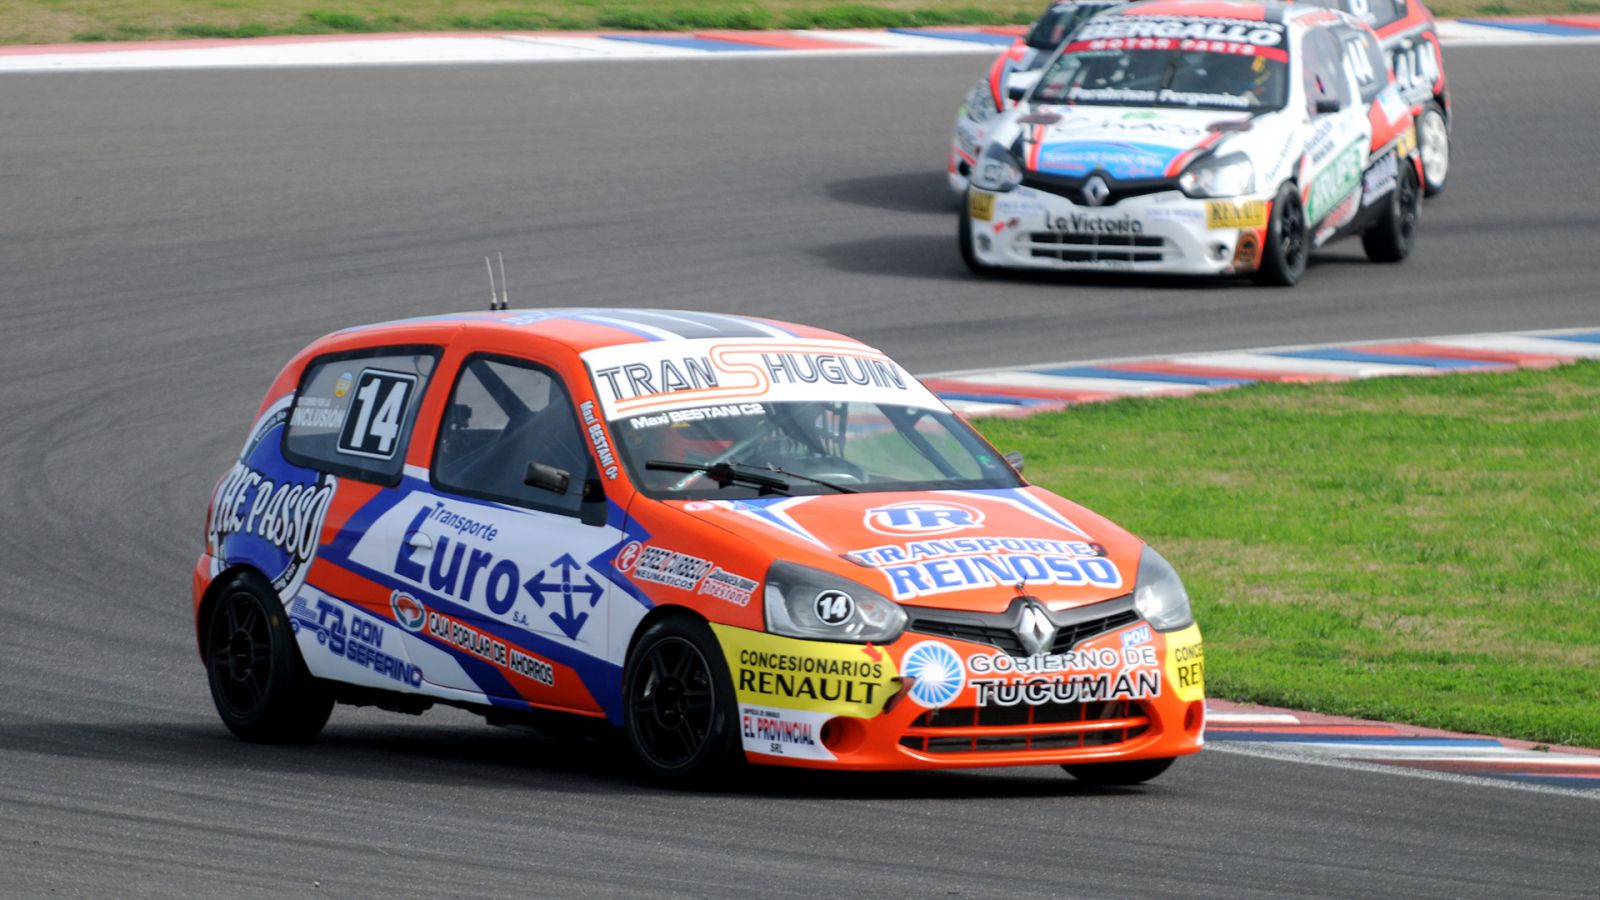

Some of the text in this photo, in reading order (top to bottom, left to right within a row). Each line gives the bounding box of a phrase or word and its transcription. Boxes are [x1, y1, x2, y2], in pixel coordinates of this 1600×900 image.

[1077, 20, 1282, 46] BERGALLO
[1089, 37, 1256, 55] MOTOR PARTS
[350, 378, 408, 452] 14
[630, 412, 670, 430] Maxi
[671, 405, 742, 424] BESTANI
[579, 400, 597, 427] Maxi
[588, 422, 616, 468] BESTANI
[429, 501, 499, 541] Transporte
[869, 506, 978, 528] TR
[394, 505, 520, 615] Euro
[855, 538, 1097, 565] TRANSPORTE
[635, 568, 695, 590] NEUMATICOS
[886, 554, 1120, 597] REINOSO
[512, 611, 529, 626] S.A.
[819, 596, 848, 620] 14
[350, 614, 384, 649] DON
[346, 638, 423, 689] SEFERINO
[429, 612, 554, 686] CAJA POPULAR DE AHORROS
[739, 649, 883, 679] CONCESIONARIOS
[969, 647, 1157, 673] GOBIERNO DE
[738, 668, 882, 705] RENAULT
[971, 667, 1161, 706] TUCUMÁN
[743, 715, 815, 746] EL PROVINCIAL
